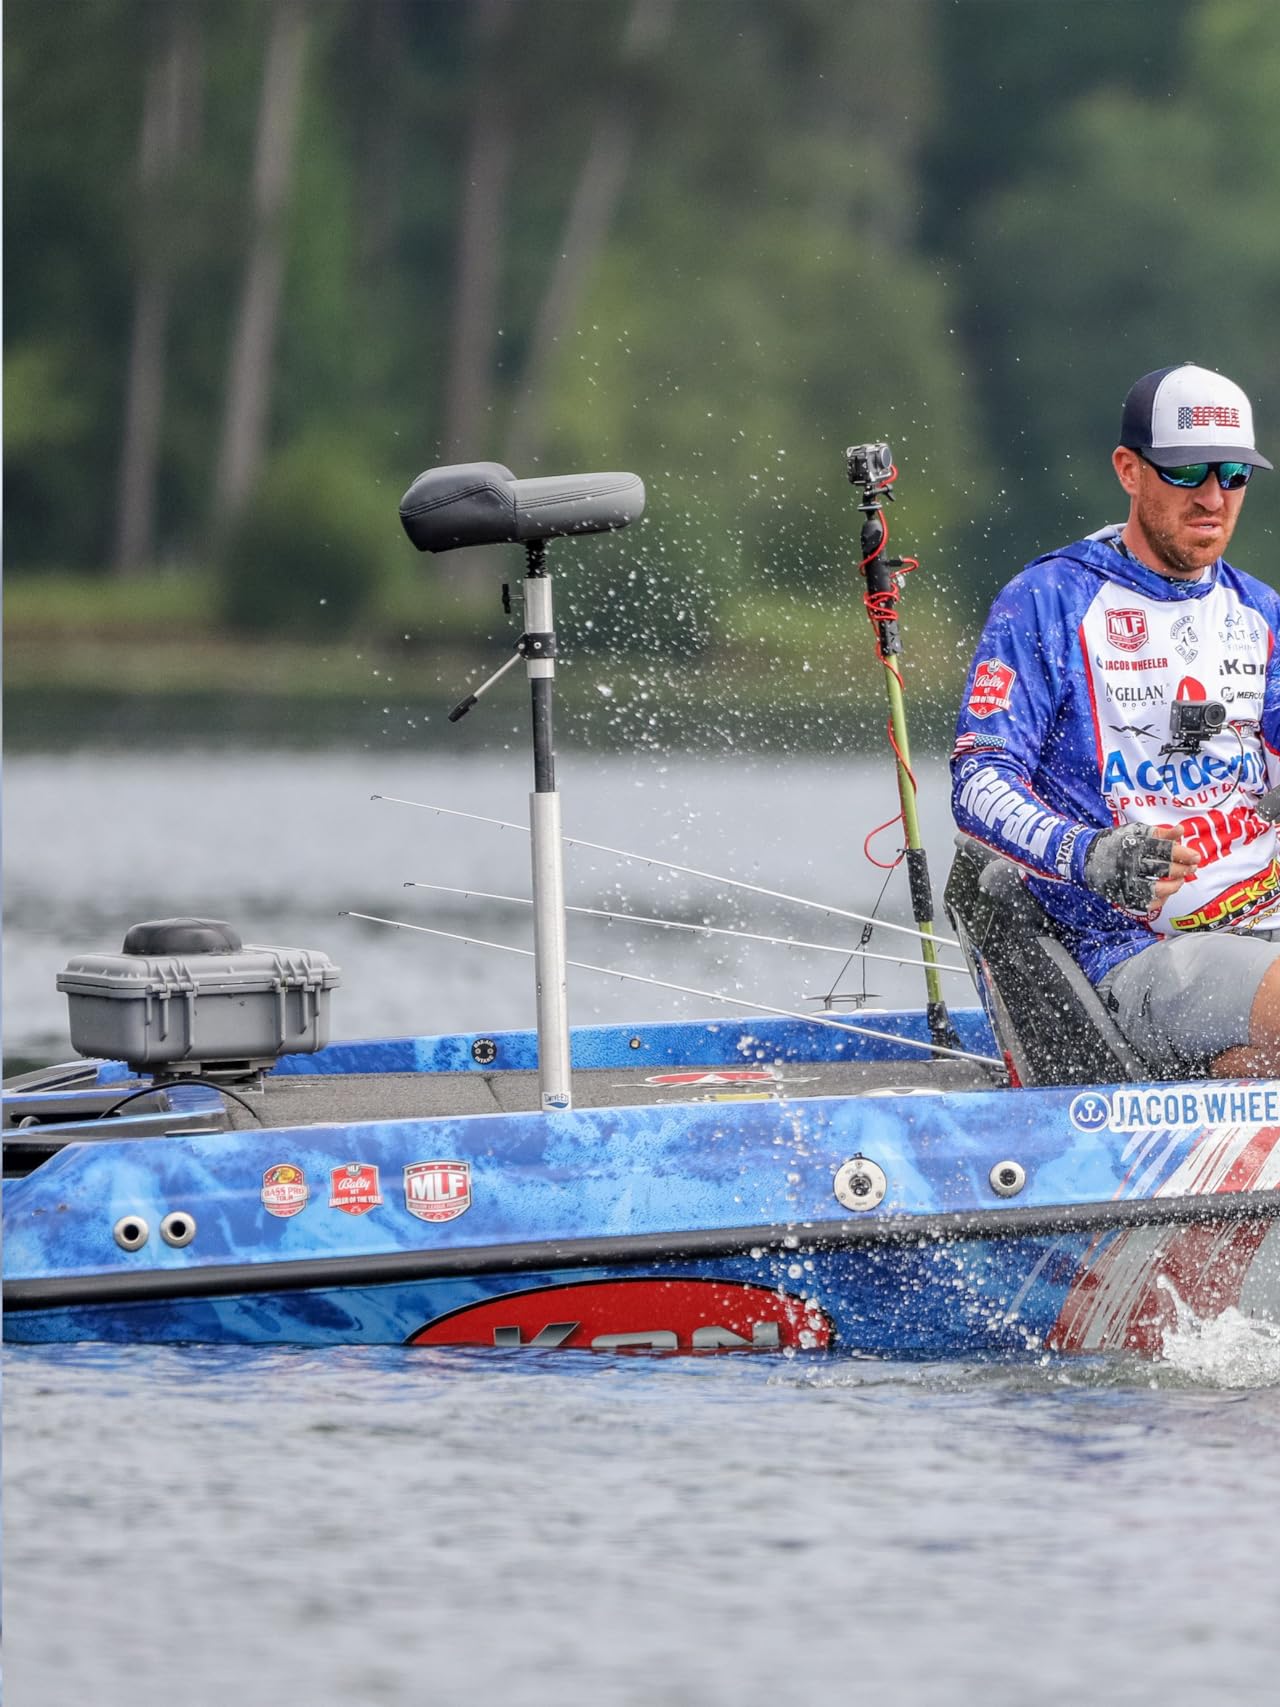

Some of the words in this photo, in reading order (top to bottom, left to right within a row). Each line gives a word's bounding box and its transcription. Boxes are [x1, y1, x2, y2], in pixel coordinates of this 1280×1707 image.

[1105, 660, 1130, 671] JACOB
[1131, 657, 1169, 671] WHEELER
[1106, 682, 1165, 702] MGELLAN
[1115, 1094, 1199, 1127] JACOB
[338, 1177, 371, 1191] Bally
[411, 1173, 464, 1201] MLF
